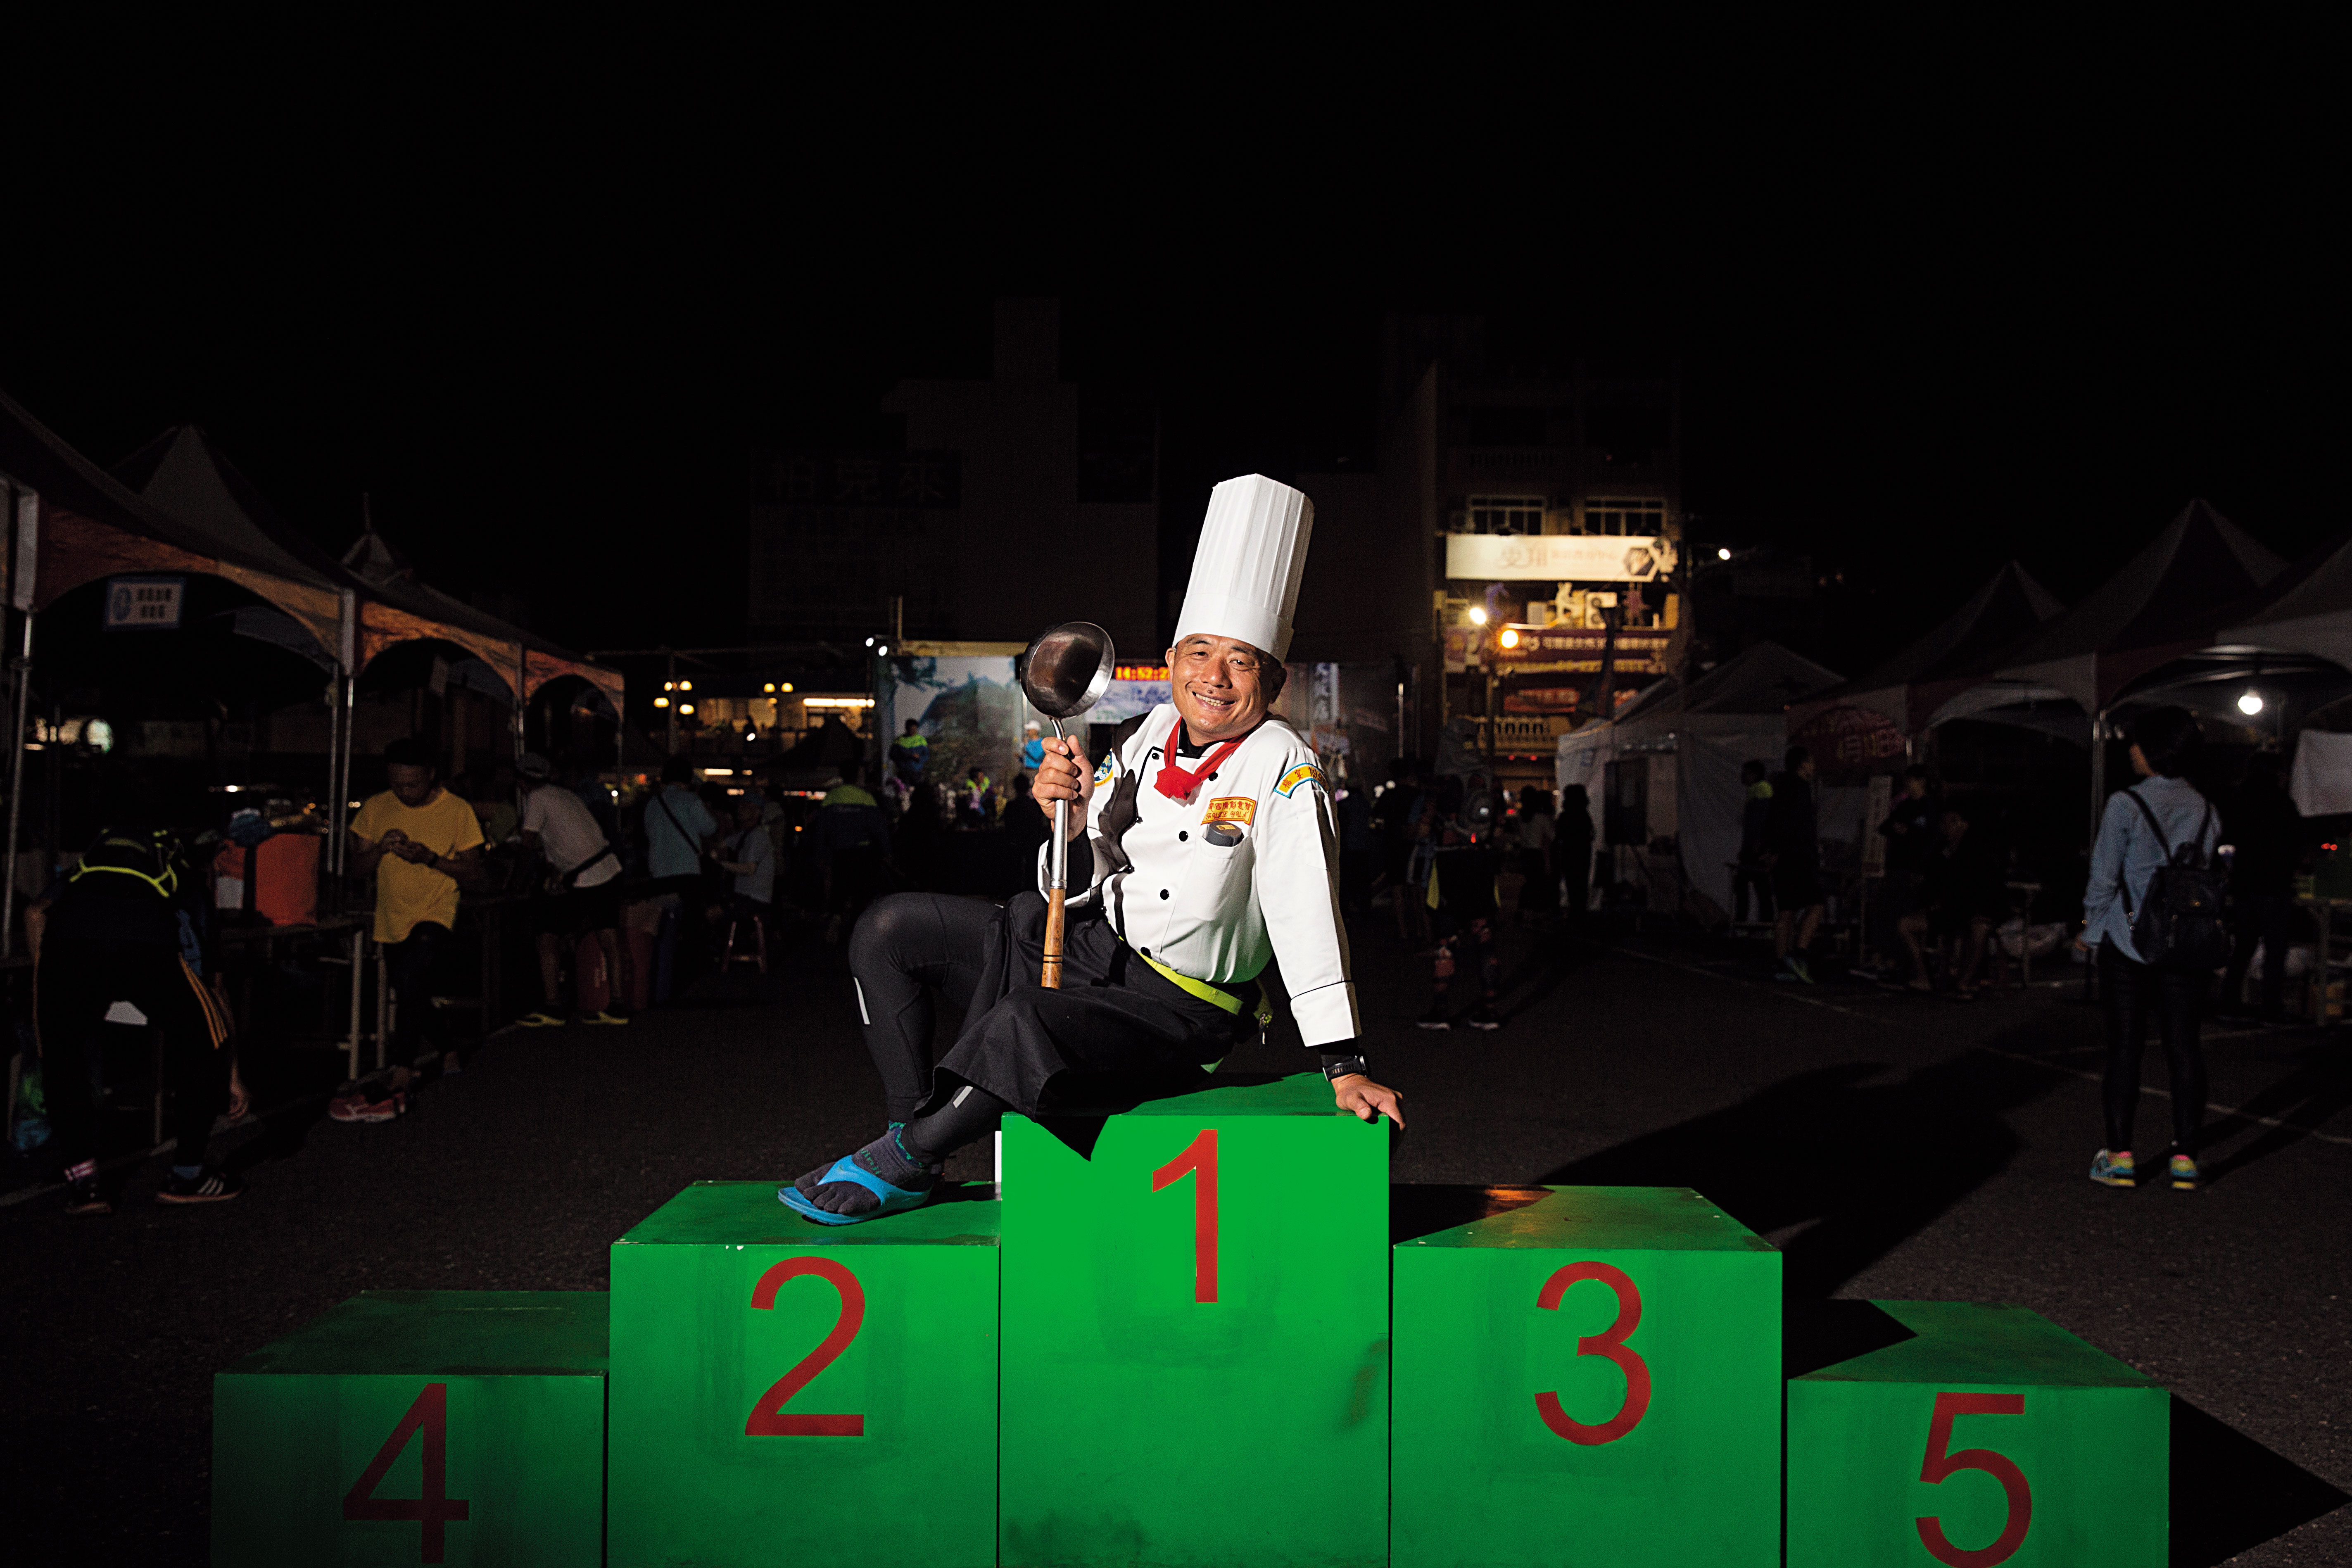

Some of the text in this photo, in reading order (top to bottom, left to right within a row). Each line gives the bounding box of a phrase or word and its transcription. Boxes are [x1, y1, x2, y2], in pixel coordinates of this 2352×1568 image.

[1116, 666, 1170, 681] 14:52:2
[1152, 1129, 1218, 1303] 1
[745, 1256, 865, 1436] 2
[1534, 1261, 1651, 1445] 3
[342, 1383, 470, 1563] 4
[1916, 1392, 2031, 1568] 5
